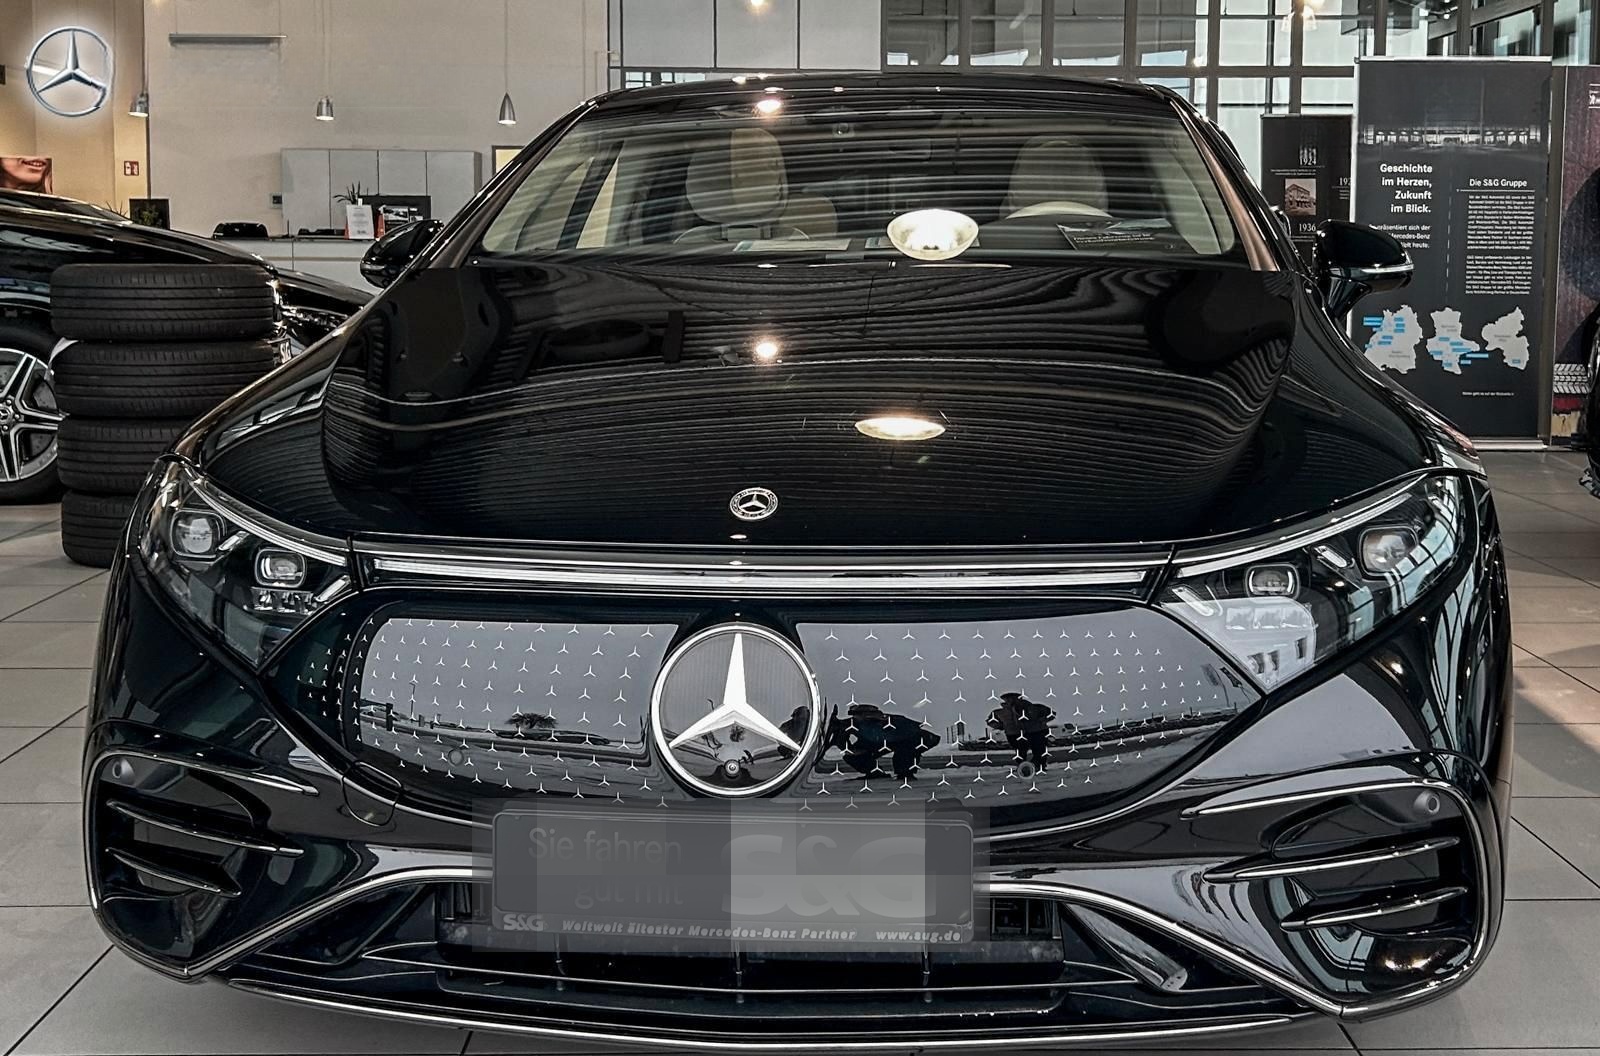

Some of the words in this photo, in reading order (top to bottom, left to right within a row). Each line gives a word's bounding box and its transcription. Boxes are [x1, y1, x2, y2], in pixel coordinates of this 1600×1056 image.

[1379, 163, 1433, 173] Geschichte
[1381, 176, 1394, 186] im
[1396, 176, 1432, 189] Herzen,
[1469, 178, 1482, 187] Die
[1483, 178, 1500, 187] S&G
[1500, 178, 1528, 189] Gruppe
[1394, 190, 1433, 200] Zukunft
[1390, 203, 1403, 213] im
[1405, 203, 1432, 213] Blick.
[1299, 222, 1317, 232] 1936
[528, 827, 574, 861] Sie
[583, 830, 682, 865] fahren
[720, 833, 937, 919] S&G
[574, 877, 624, 910] gut
[503, 913, 544, 932] S&G
[562, 919, 623, 934] Weltweit
[628, 921, 684, 937] ältester
[688, 924, 796, 940] Mercedes-Benz
[801, 927, 856, 940] Partner
[876, 929, 962, 943] www.sug.de
